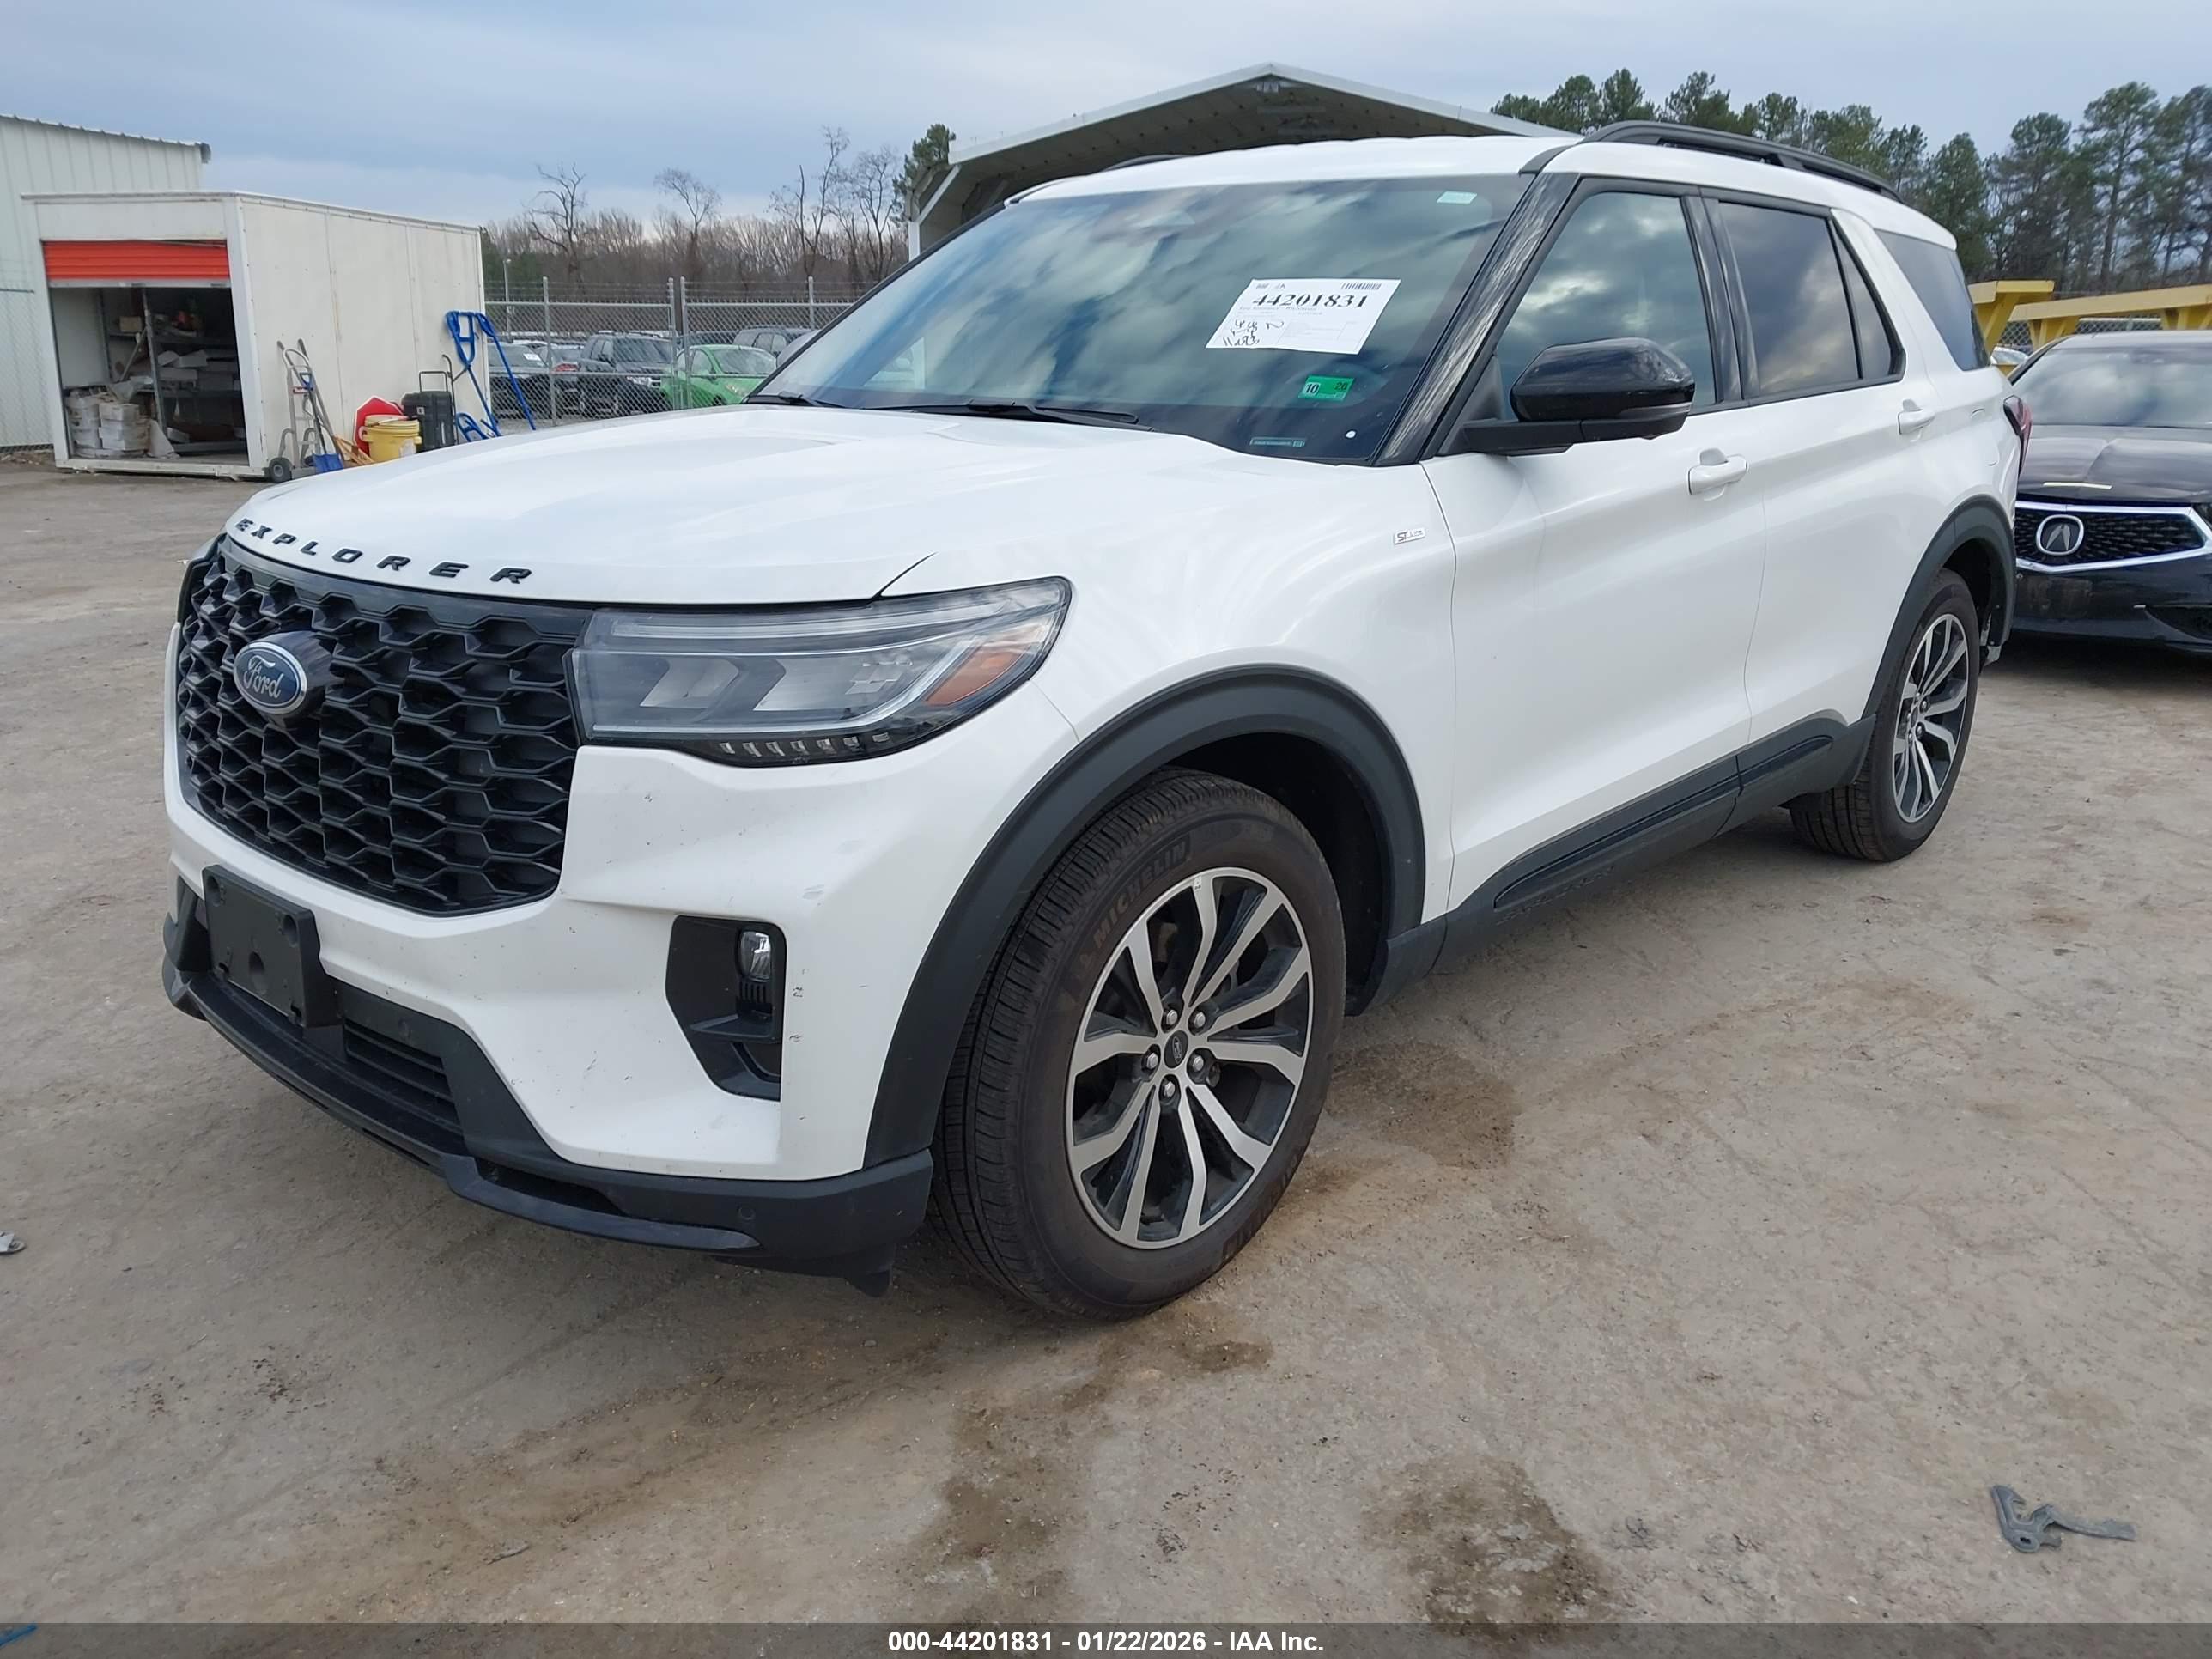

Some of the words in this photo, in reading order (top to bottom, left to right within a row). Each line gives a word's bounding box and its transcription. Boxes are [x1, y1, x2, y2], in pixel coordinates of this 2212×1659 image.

[1253, 294, 1369, 308] 44201831
[1305, 383, 1321, 394] 10
[1334, 381, 1347, 392] 26
[235, 518, 532, 584] EXPLORER
[243, 654, 284, 699] Ford
[1092, 840, 1188, 949] MICHELIN
